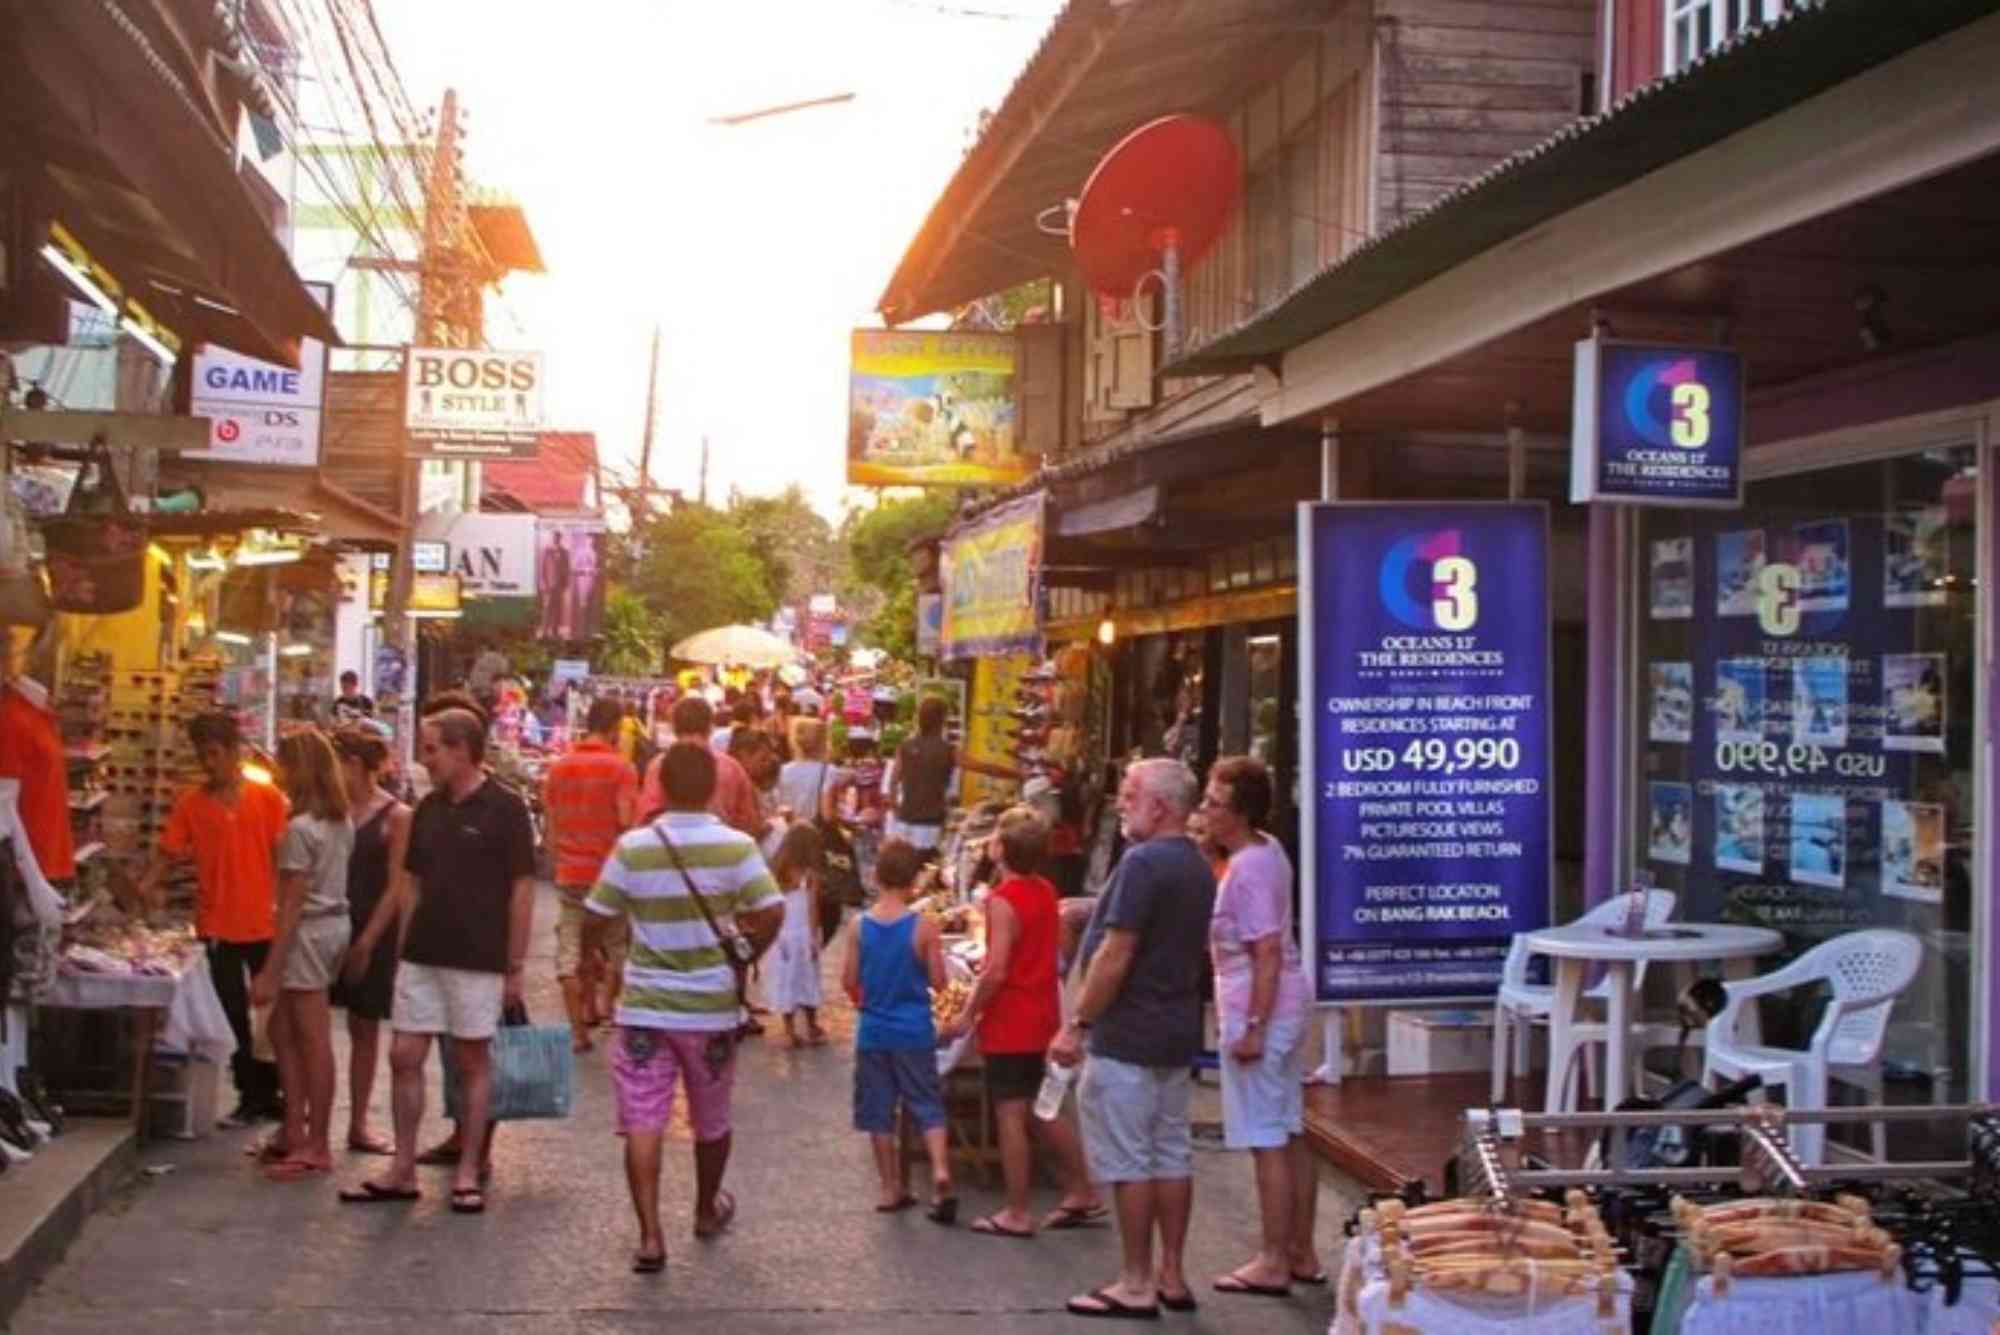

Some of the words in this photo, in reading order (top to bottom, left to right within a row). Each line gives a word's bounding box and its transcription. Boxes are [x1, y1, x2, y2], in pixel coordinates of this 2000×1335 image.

[205, 367, 298, 394] GAME
[415, 357, 535, 391] BOSS
[442, 394, 505, 412] STYLE
[264, 411, 299, 427] DS
[1626, 450, 1686, 464] OCEANS
[1608, 462, 1637, 475] THE
[1641, 464, 1730, 479] RESIDENCES
[1382, 636, 1453, 650] OCEANS
[1360, 651, 1397, 666] THE
[1399, 651, 1504, 666] RESIDENCES
[1328, 697, 1415, 713] OWNERSHIP
[1417, 696, 1432, 711] IN
[1435, 695, 1484, 710] BEACH
[1486, 694, 1533, 710] FRONT
[1341, 717, 1426, 734] RESIDENCES
[1430, 716, 1494, 732] STARTING
[1343, 749, 1395, 772] USD
[1402, 738, 1520, 774] 49,990
[1325, 783, 1336, 797] 2
[1337, 781, 1411, 797] BEDROOM
[1414, 780, 1458, 795] FULLY
[1459, 778, 1538, 794] FURNISHED
[1359, 802, 1413, 817] PRIVATE
[1416, 801, 1454, 816] POOL
[1457, 801, 1504, 815] VILLAS
[1361, 822, 1456, 838] PICTURESQUE
[1458, 821, 1504, 836] VIEWS
[1342, 845, 1365, 860] 7%
[1366, 843, 1464, 859] GUARANTEED
[1465, 842, 1522, 857] RETURN
[1365, 886, 1425, 900] PERFECT
[1428, 884, 1501, 899] LOCATION
[1354, 908, 1378, 922] ON
[1381, 906, 1424, 922] BANG
[1426, 905, 1458, 921] RAK
